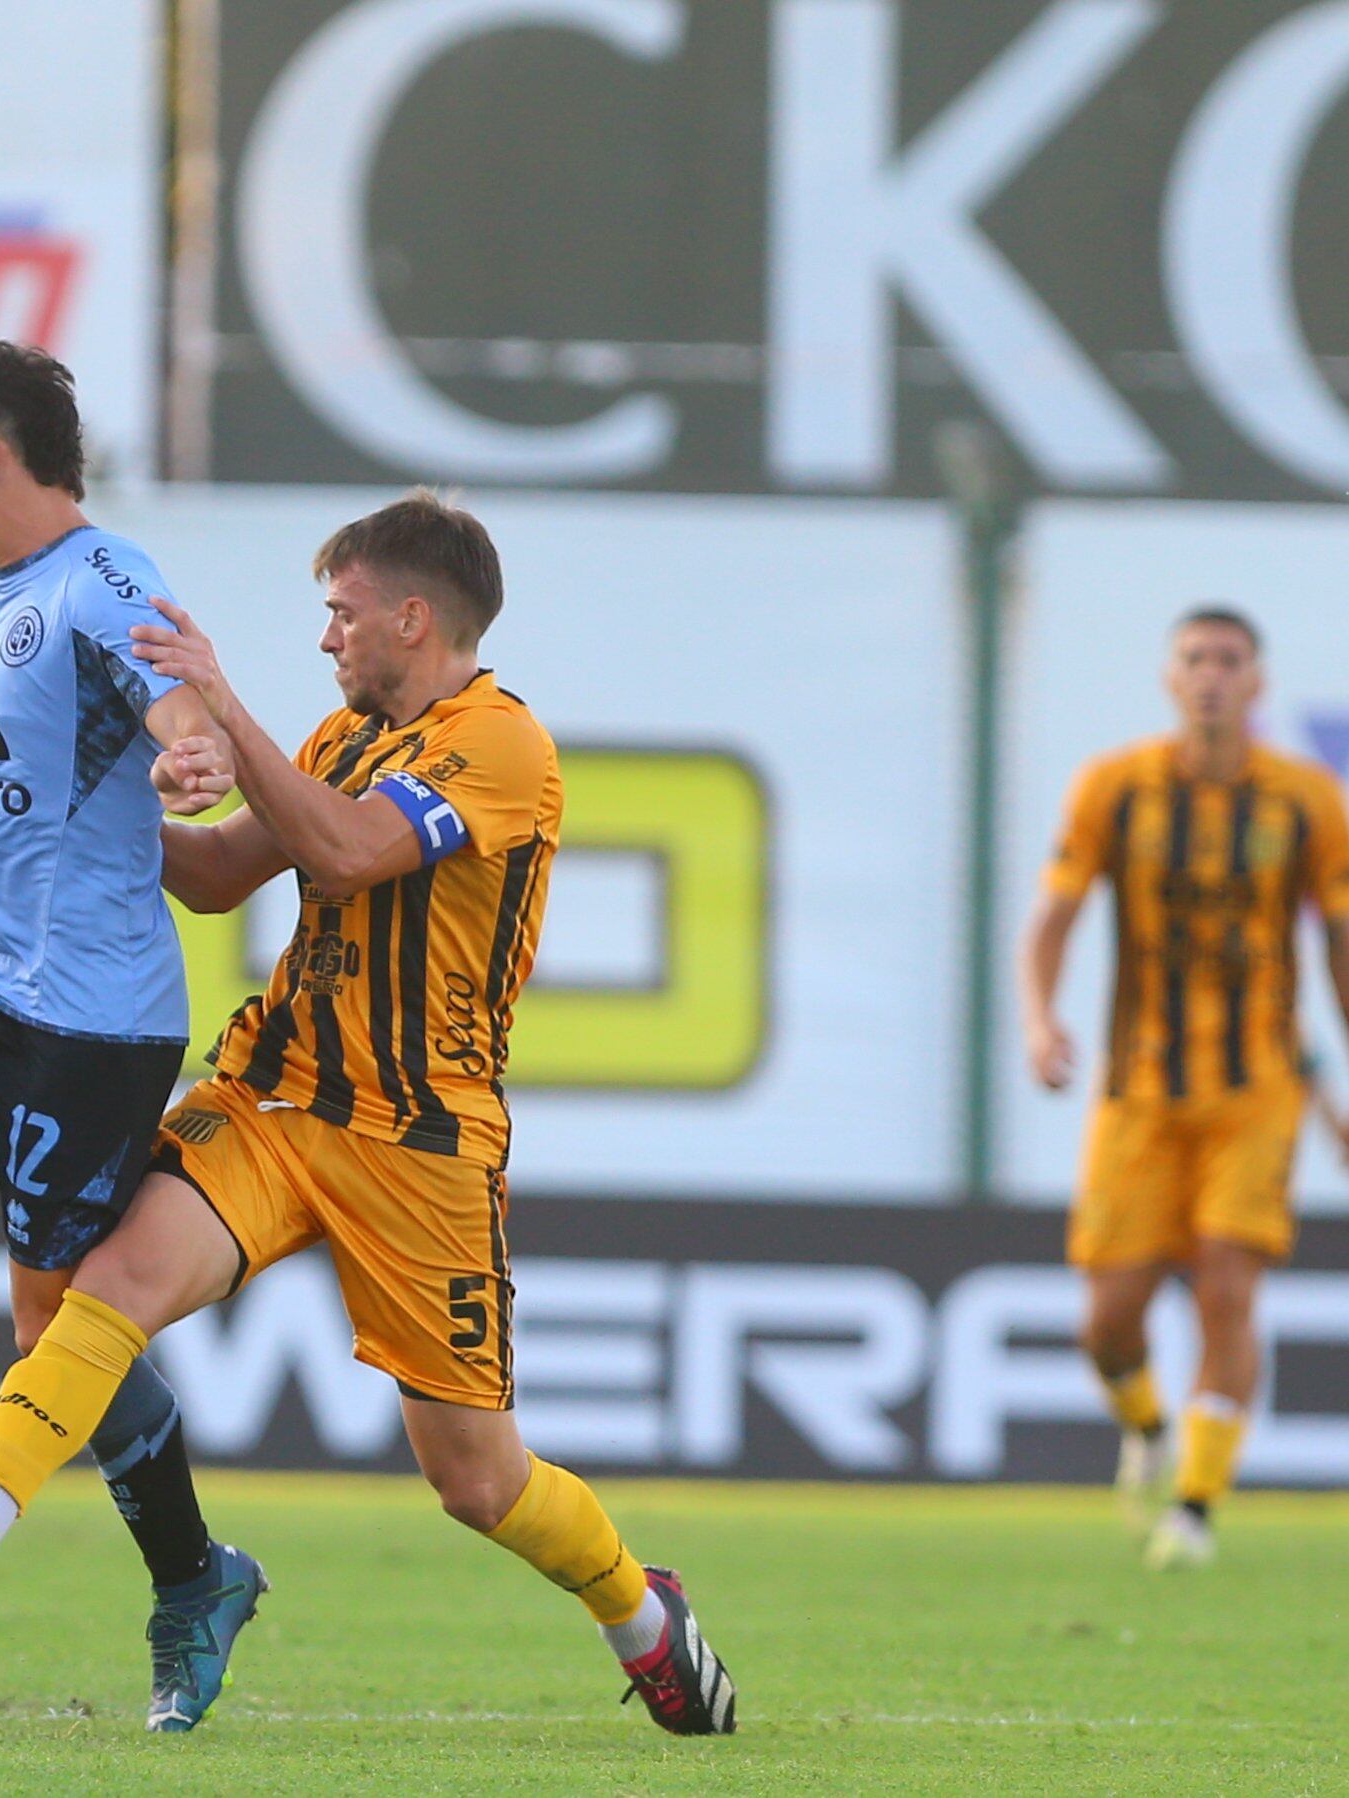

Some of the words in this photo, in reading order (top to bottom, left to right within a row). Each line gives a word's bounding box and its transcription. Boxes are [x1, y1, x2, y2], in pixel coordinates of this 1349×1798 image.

[390, 770, 431, 800] CER
[423, 802, 465, 849] C
[6, 1104, 61, 1196] 12
[449, 1276, 487, 1349] 5
